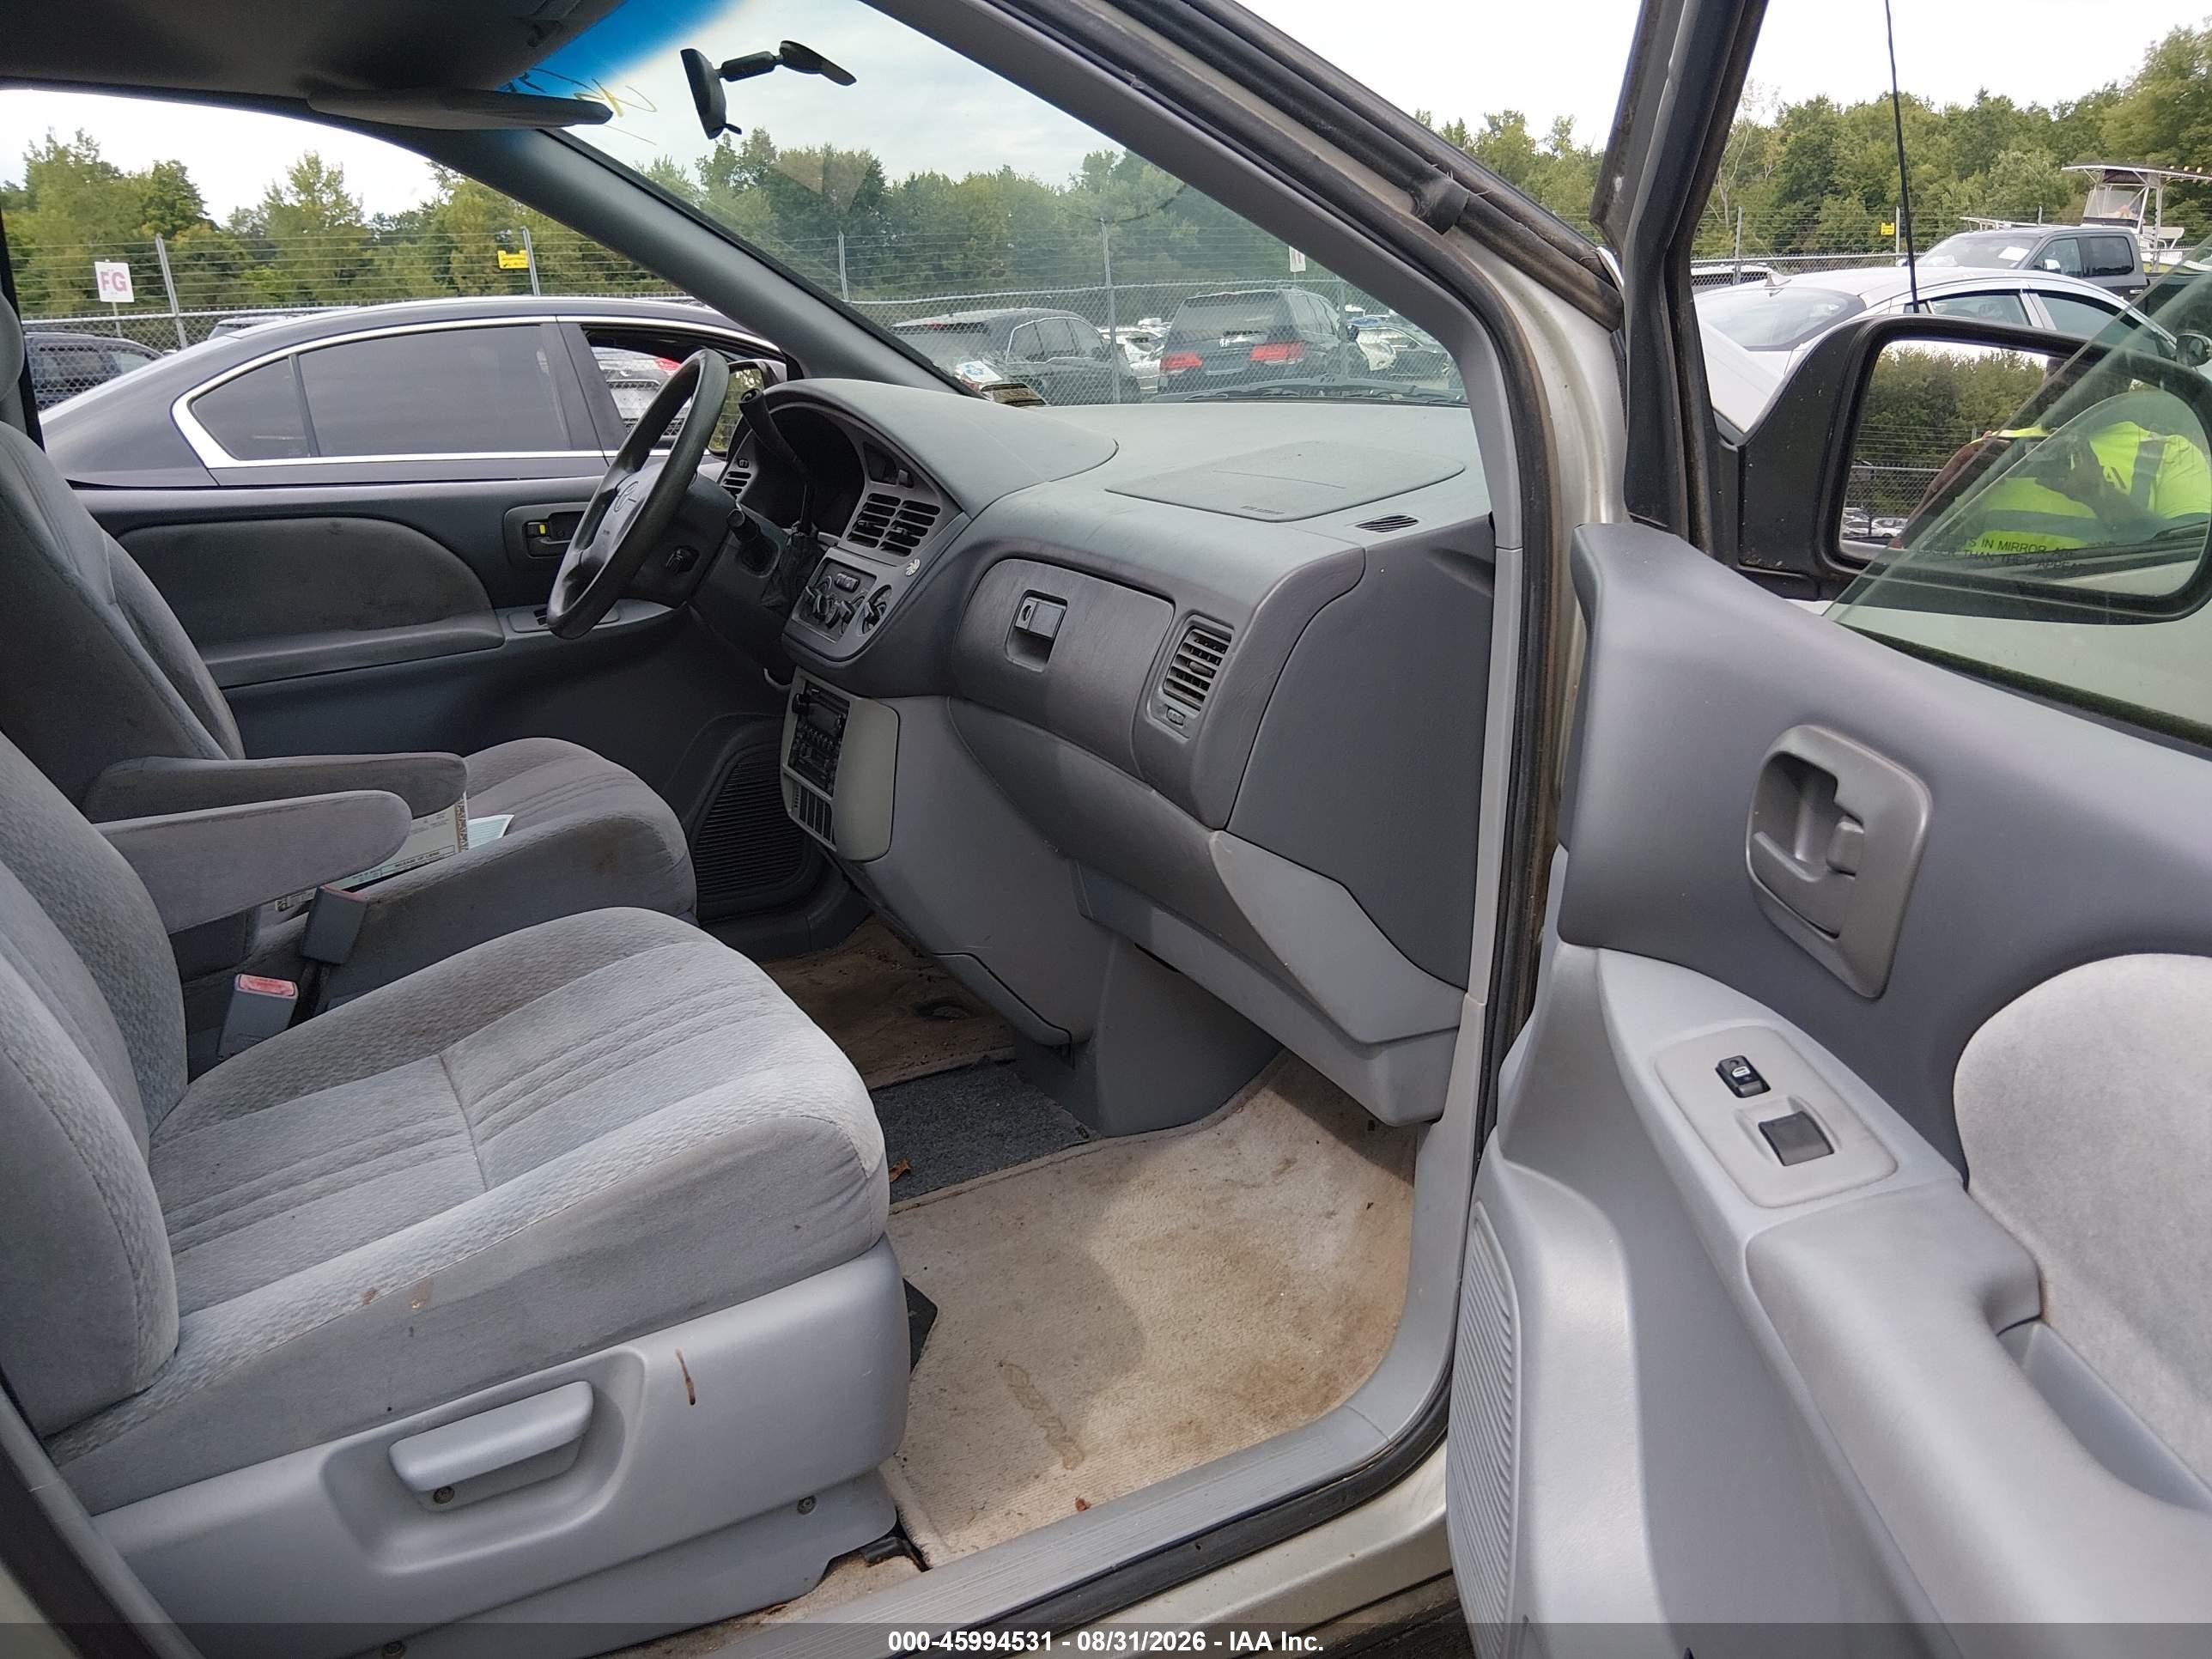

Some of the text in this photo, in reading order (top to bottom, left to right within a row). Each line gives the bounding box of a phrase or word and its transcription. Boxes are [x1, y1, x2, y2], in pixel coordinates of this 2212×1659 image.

[100, 271, 127, 291] FG
[1981, 538, 1994, 549] IN
[1997, 540, 2047, 554] MIRROR
